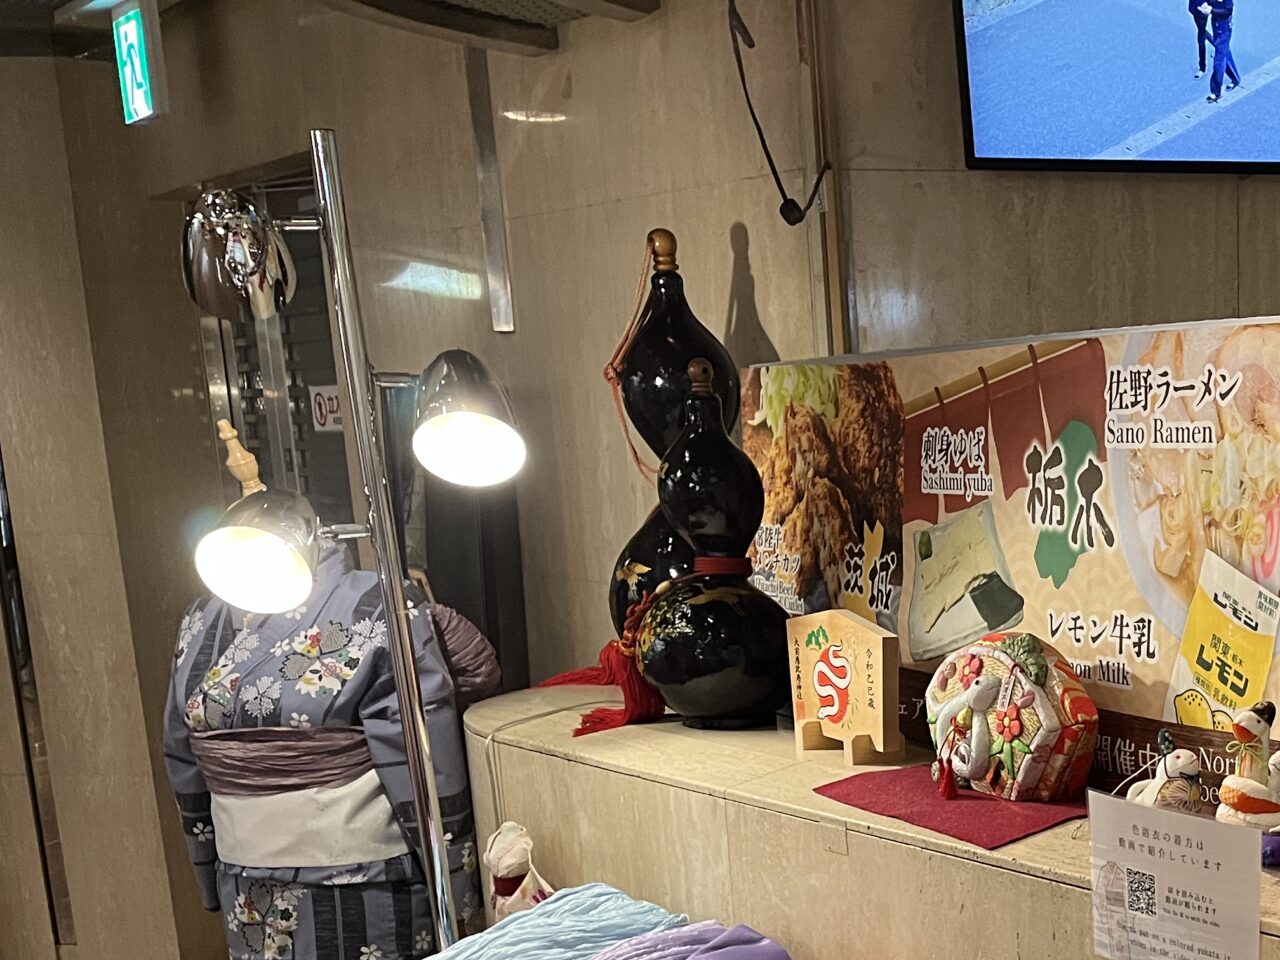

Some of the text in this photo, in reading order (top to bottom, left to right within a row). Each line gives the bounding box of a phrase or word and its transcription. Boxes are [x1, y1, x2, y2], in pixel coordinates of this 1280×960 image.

[1107, 368, 1240, 412] 佐野ラーメン
[923, 430, 984, 465] 刺身ゆば
[1107, 418, 1213, 444] Sano Ramen
[922, 468, 993, 499] Sashimi yuba
[1026, 444, 1115, 548] 栃木
[844, 546, 896, 610] 茨城
[1049, 613, 1156, 659] レモン牛乳
[1098, 660, 1130, 686] Milk
[1196, 643, 1249, 698] レモン
[1118, 836, 1222, 872] 動画で紹介しています
[1132, 823, 1204, 851] 色浴衣の着方は
